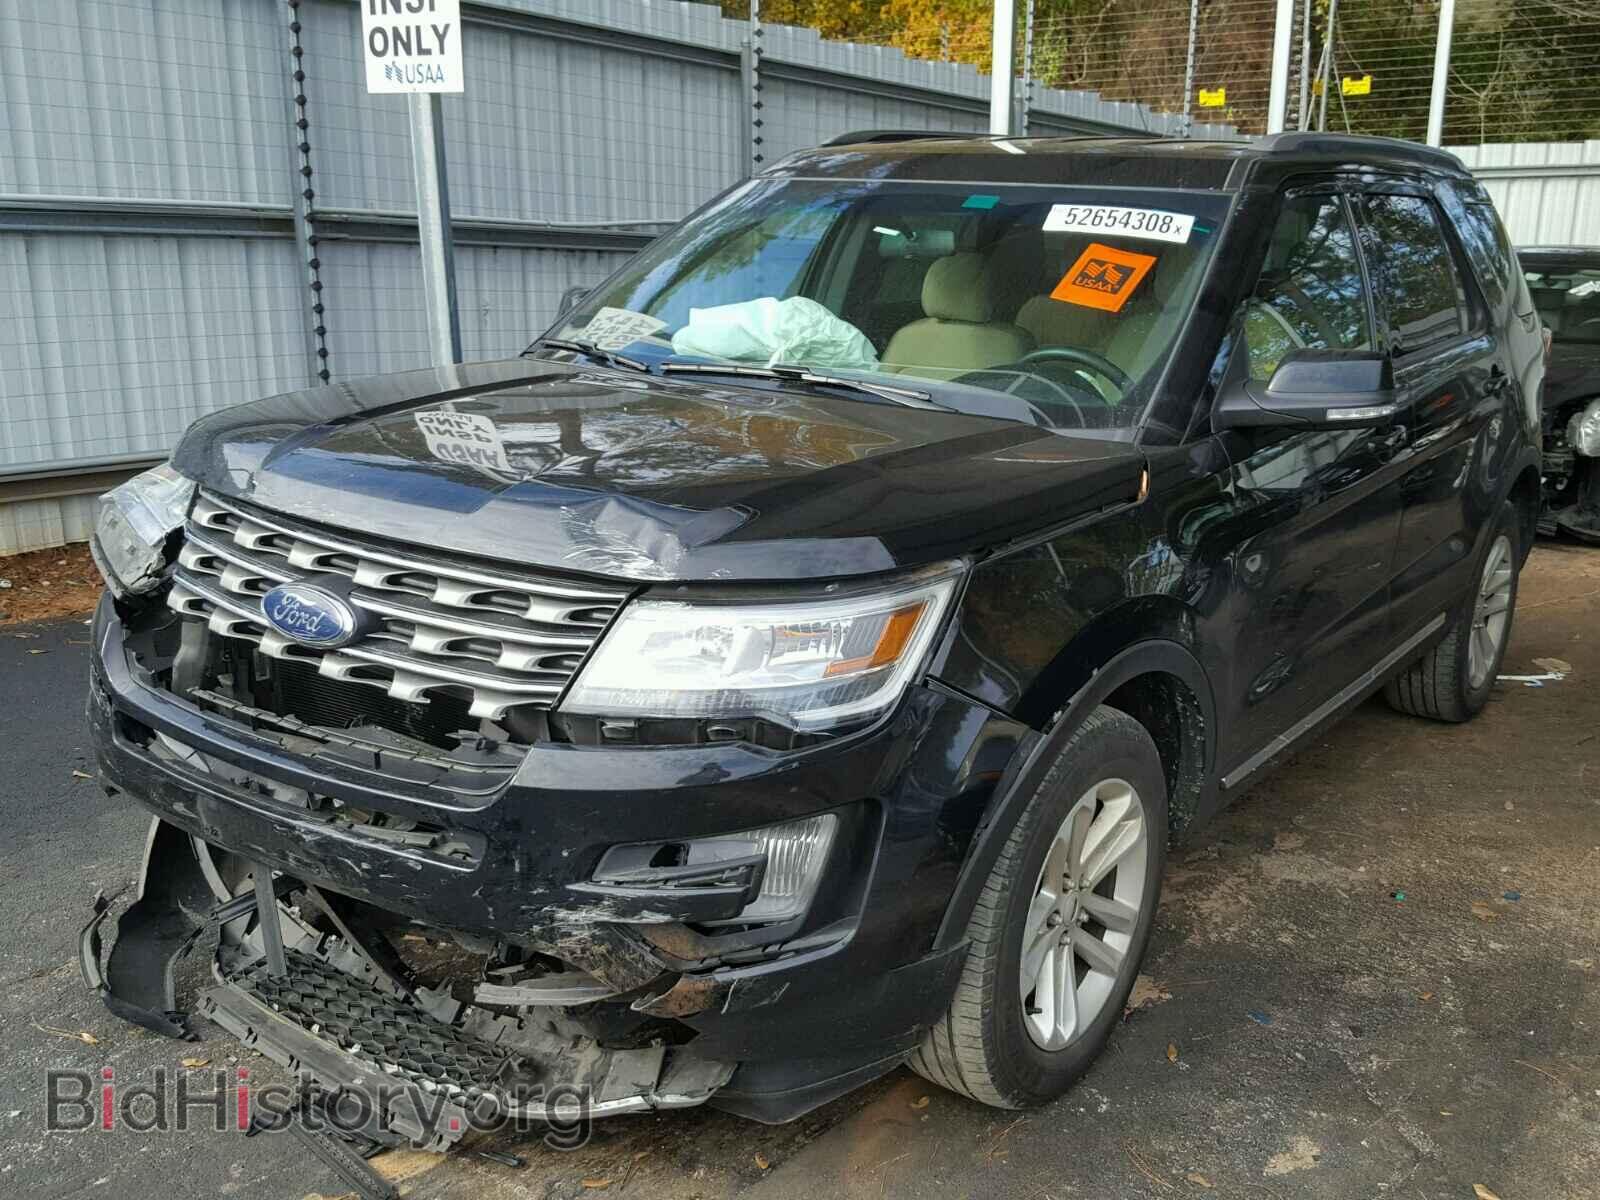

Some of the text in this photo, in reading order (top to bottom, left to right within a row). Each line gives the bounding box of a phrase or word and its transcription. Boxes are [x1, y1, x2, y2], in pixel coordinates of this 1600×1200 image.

[369, 24, 450, 58] ONLY
[405, 63, 445, 84] USAA
[1075, 276, 1113, 293] USAA
[274, 592, 329, 632] Ford
